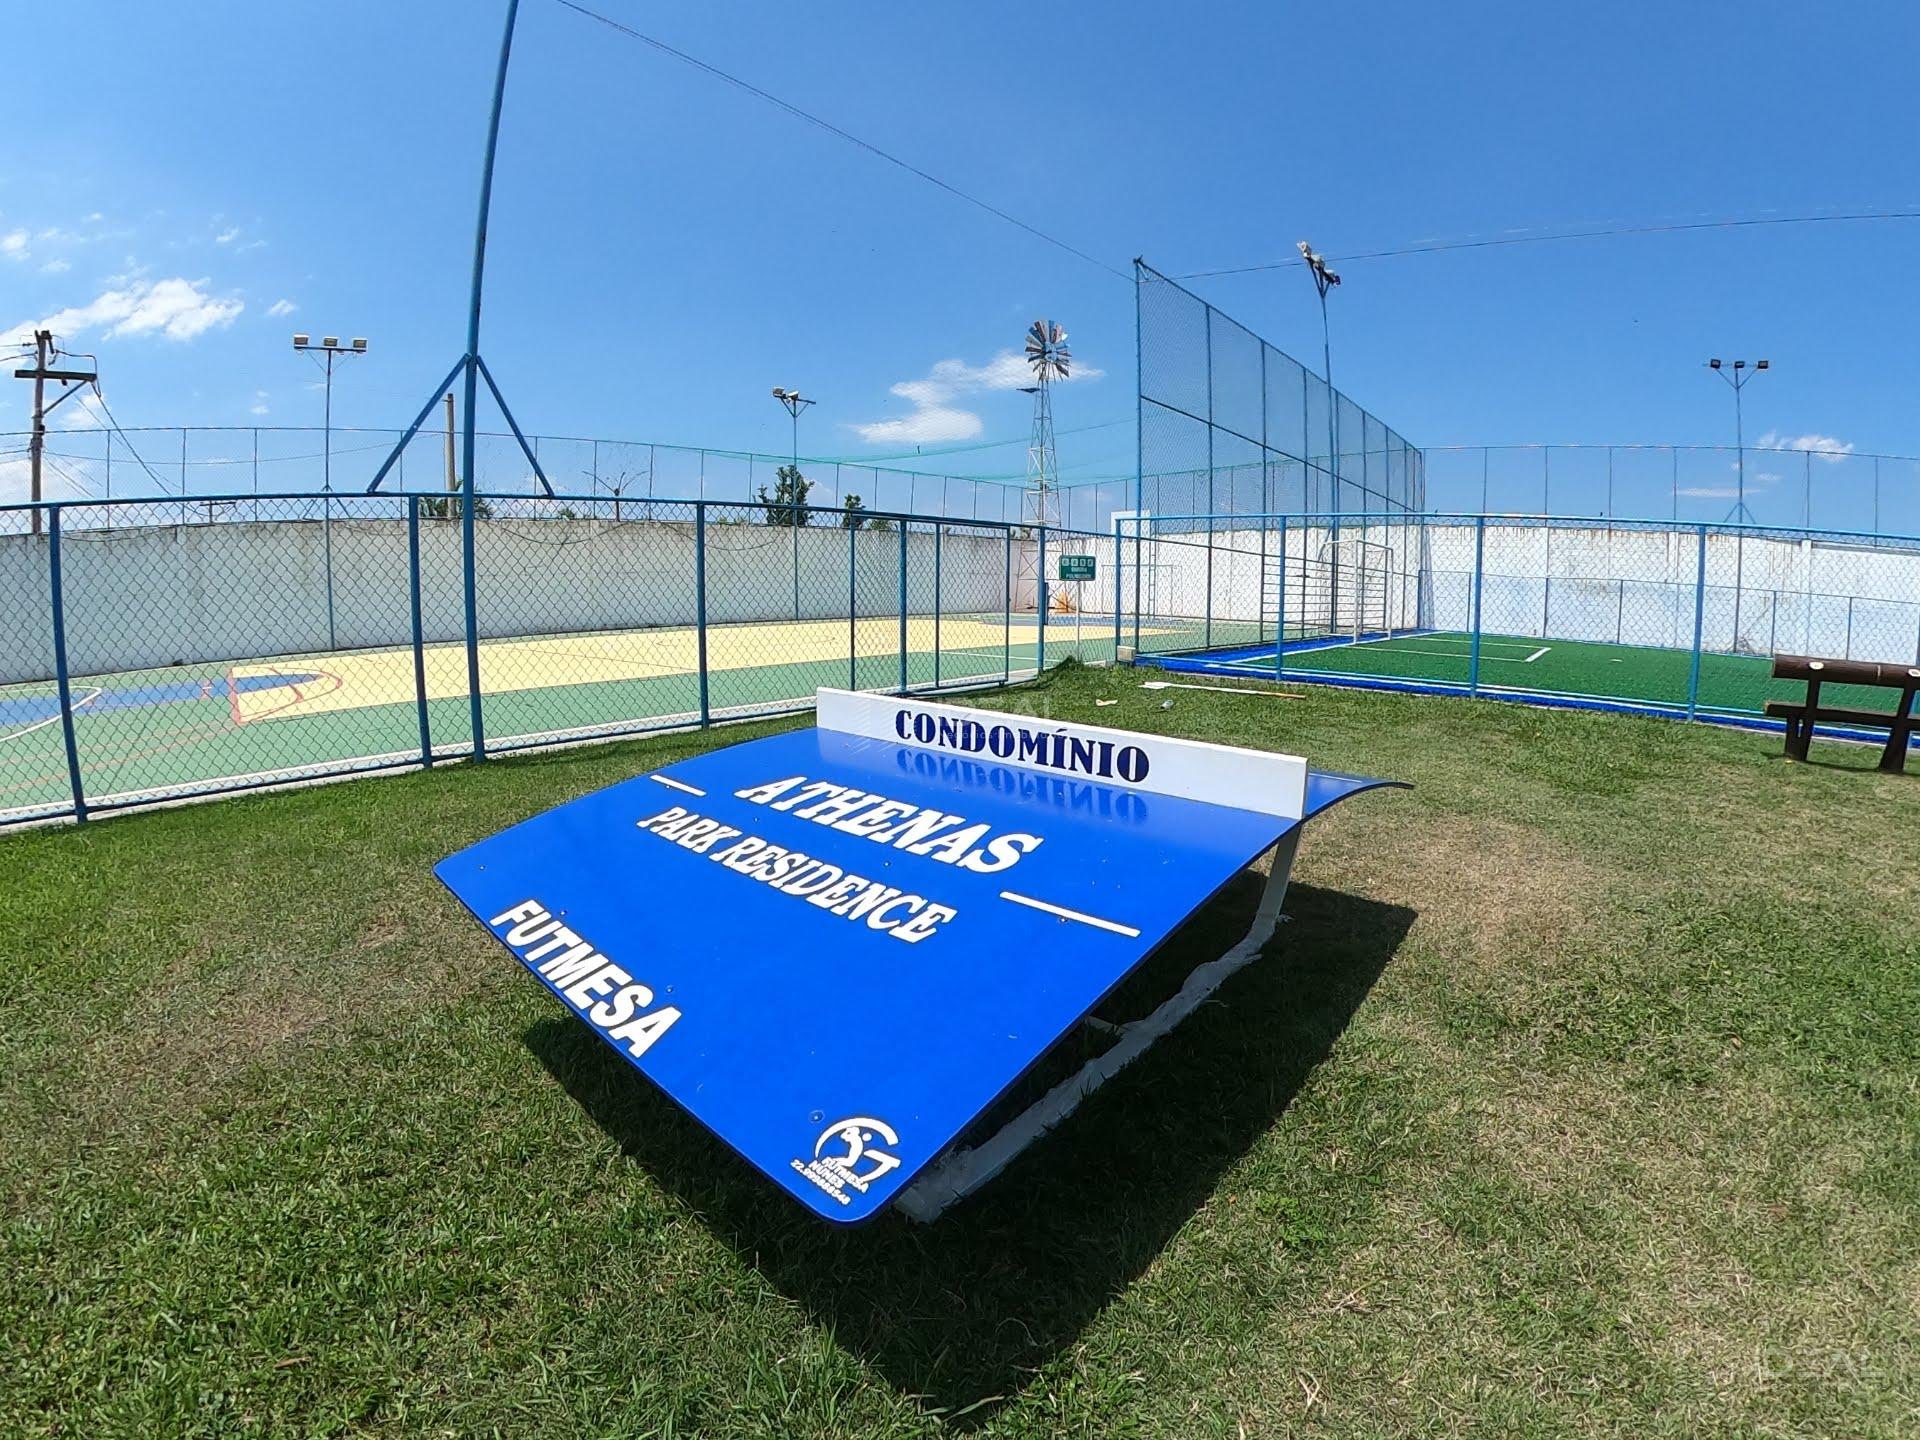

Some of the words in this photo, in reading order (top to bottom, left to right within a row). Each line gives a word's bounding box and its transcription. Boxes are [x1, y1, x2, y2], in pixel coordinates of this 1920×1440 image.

[896, 709, 1150, 783] CONDOMÍNIO
[735, 775, 1043, 873] ATHENAS
[637, 806, 742, 853] PARK
[709, 836, 957, 943] RESIDENCE
[489, 899, 682, 1058] FUTMESA
[808, 1160, 846, 1189] NUNES
[821, 1156, 869, 1193] FUTMESA
